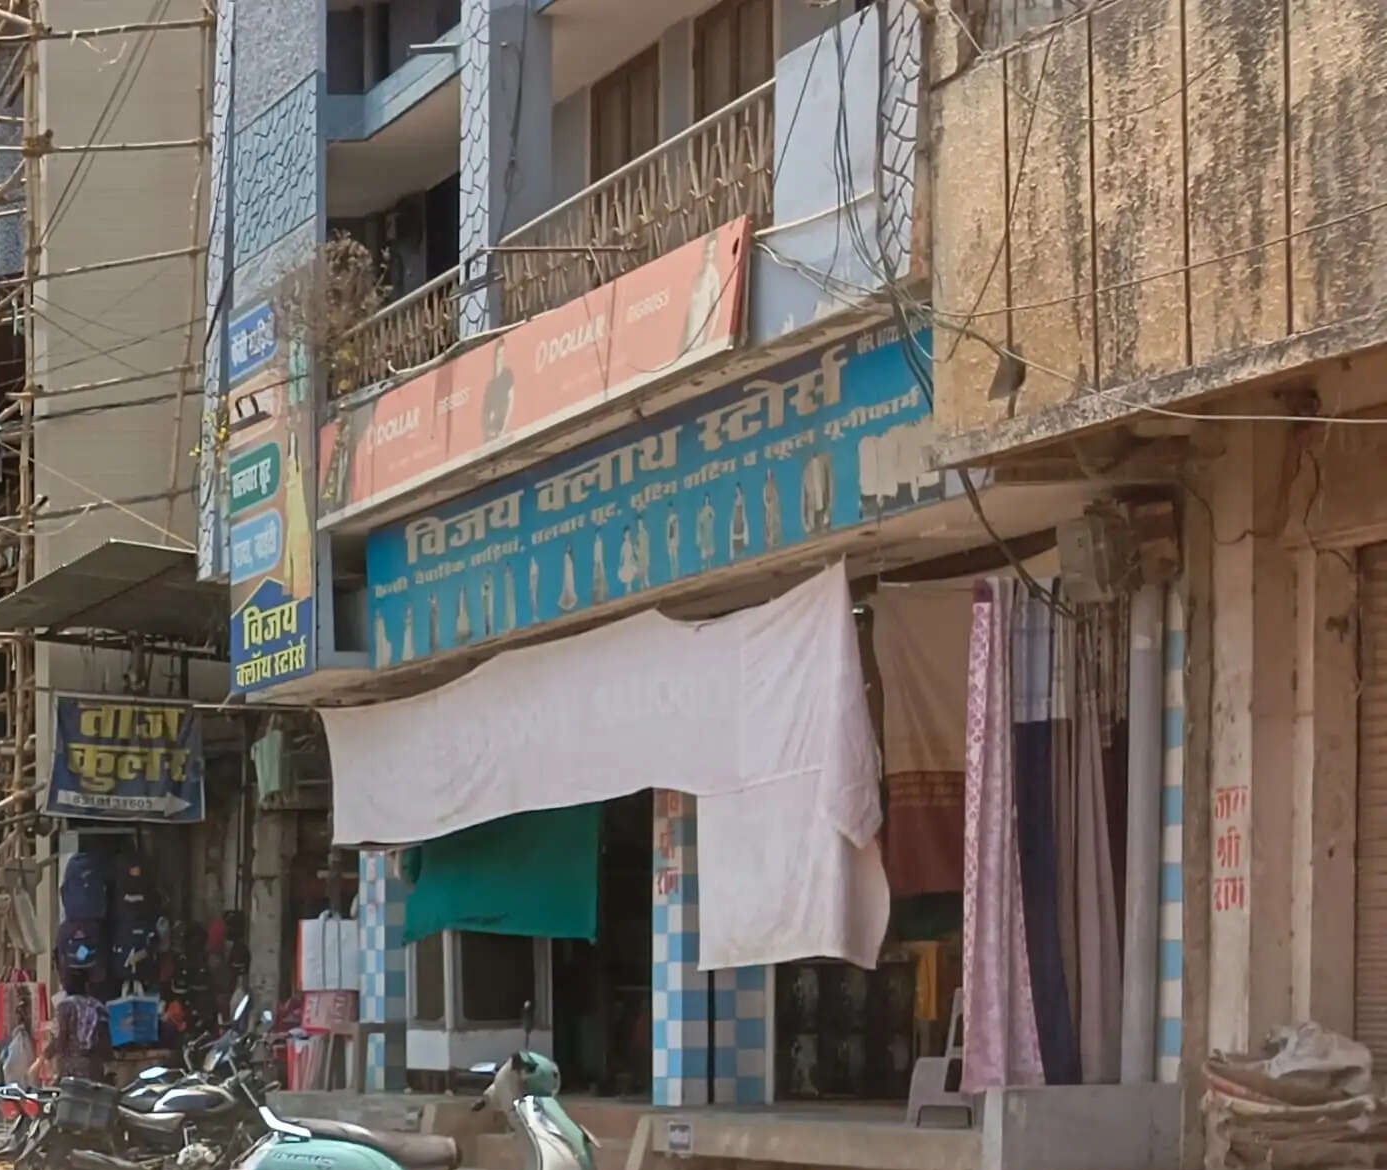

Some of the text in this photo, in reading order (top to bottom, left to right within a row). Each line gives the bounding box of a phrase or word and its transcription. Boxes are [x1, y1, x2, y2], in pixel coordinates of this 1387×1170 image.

[549, 314, 607, 364] DOLLAR
[405, 489, 524, 565] विजय
[696, 343, 849, 452] स्टोर्स
[243, 599, 298, 651] विजय
